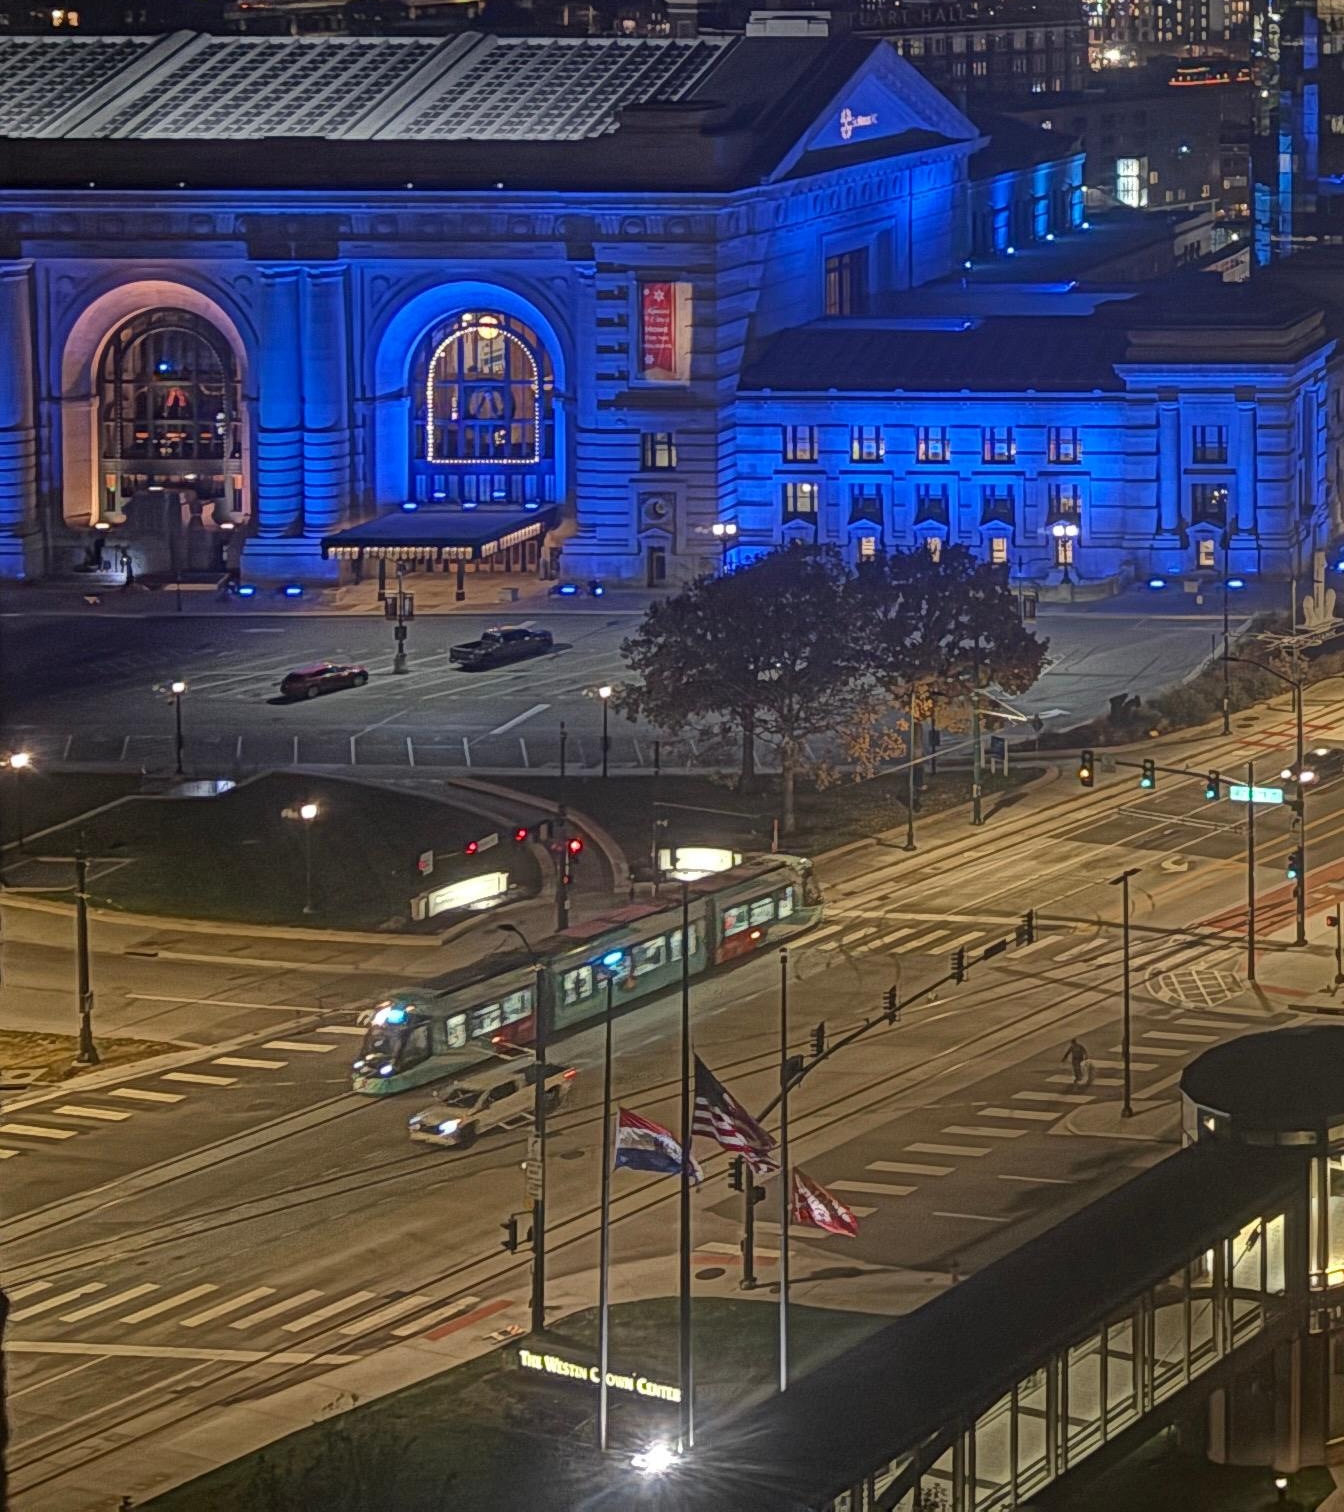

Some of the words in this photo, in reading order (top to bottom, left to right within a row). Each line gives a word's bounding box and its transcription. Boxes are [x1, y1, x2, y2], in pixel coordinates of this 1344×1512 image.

[921, 6, 966, 23] HALL
[518, 1349, 543, 1370] THE
[543, 1354, 588, 1381] WESTIN
[589, 1366, 634, 1392] COWN
[636, 1377, 682, 1403] CENTER
